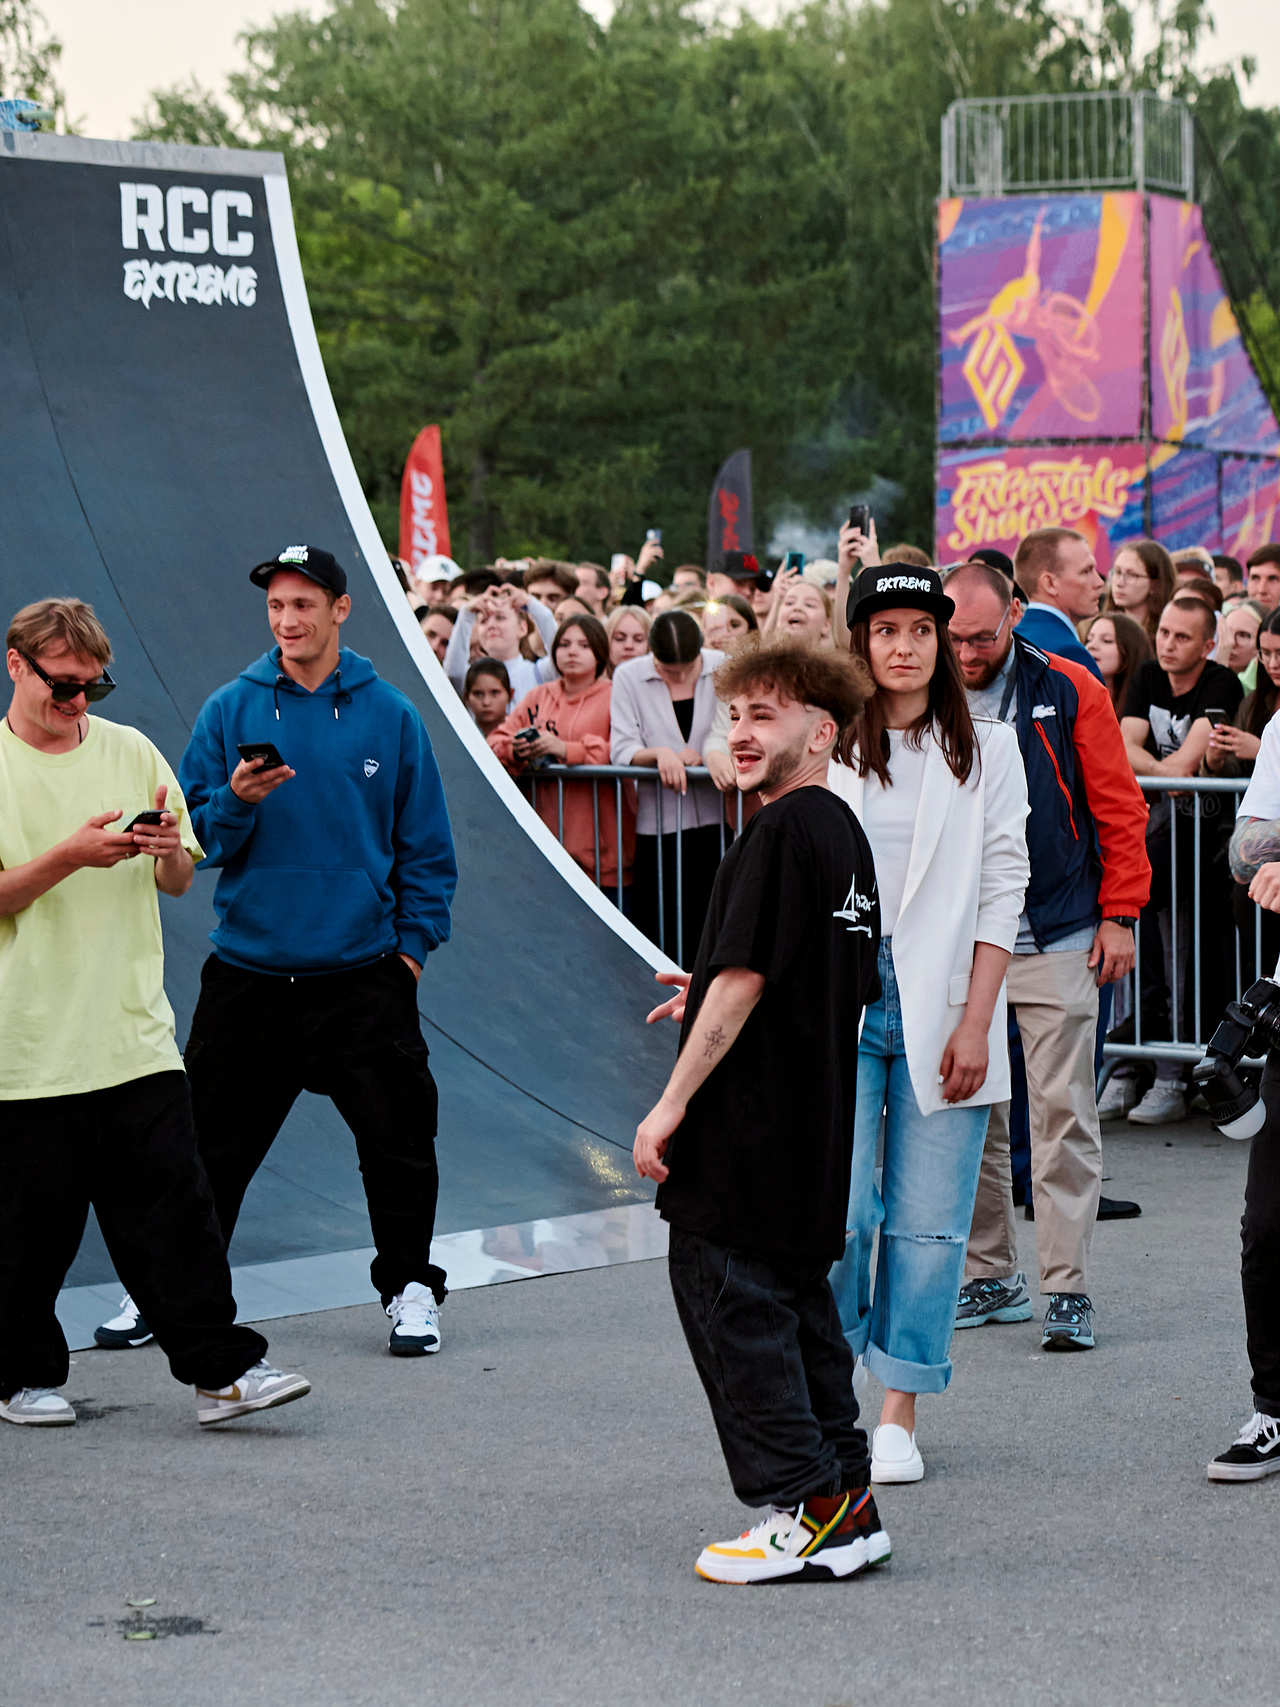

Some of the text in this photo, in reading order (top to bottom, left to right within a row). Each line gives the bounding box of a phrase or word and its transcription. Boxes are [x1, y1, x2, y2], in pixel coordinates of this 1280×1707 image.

[119, 181, 255, 257] RCC
[123, 258, 258, 310] EXTREME
[876, 575, 932, 593] EXTREME
